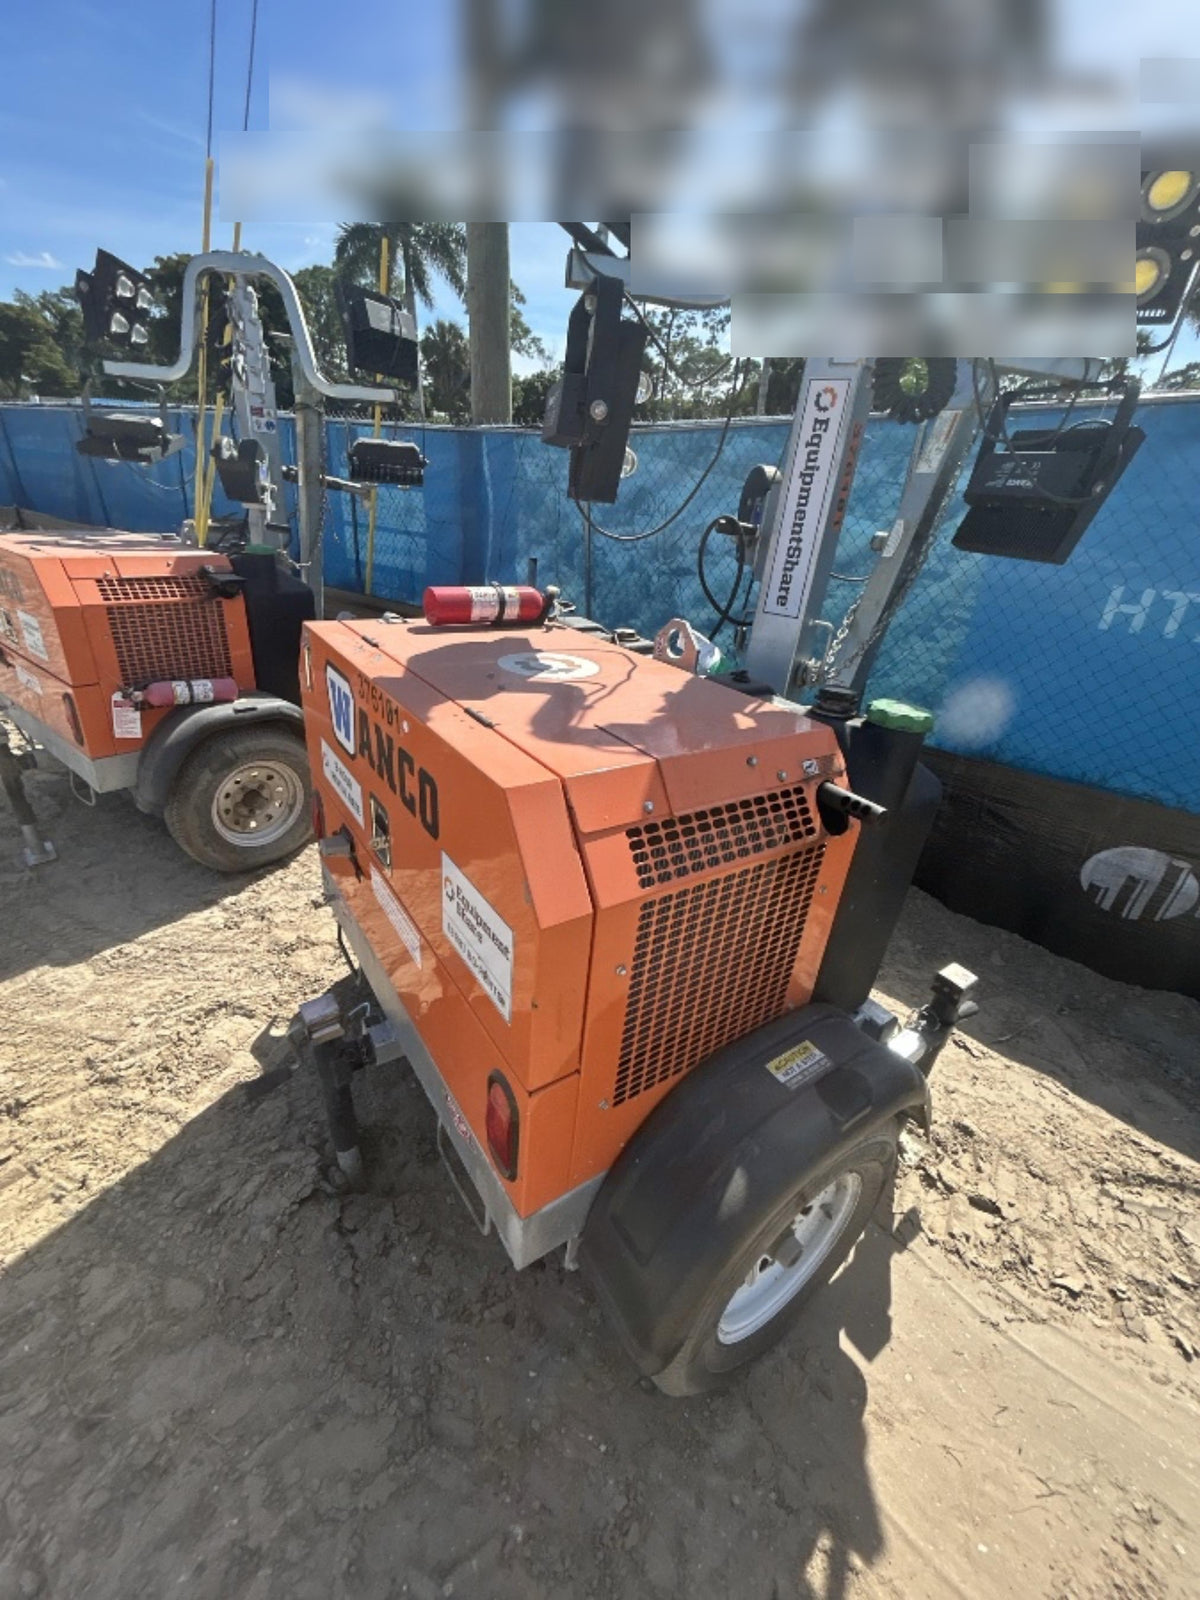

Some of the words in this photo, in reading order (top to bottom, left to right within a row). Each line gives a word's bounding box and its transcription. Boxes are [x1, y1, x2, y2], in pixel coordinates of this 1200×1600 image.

[776, 417, 830, 607] EquipmentShare
[1097, 584, 1200, 642] HT
[329, 672, 440, 841] WANCO
[456, 884, 511, 960] Equipment
